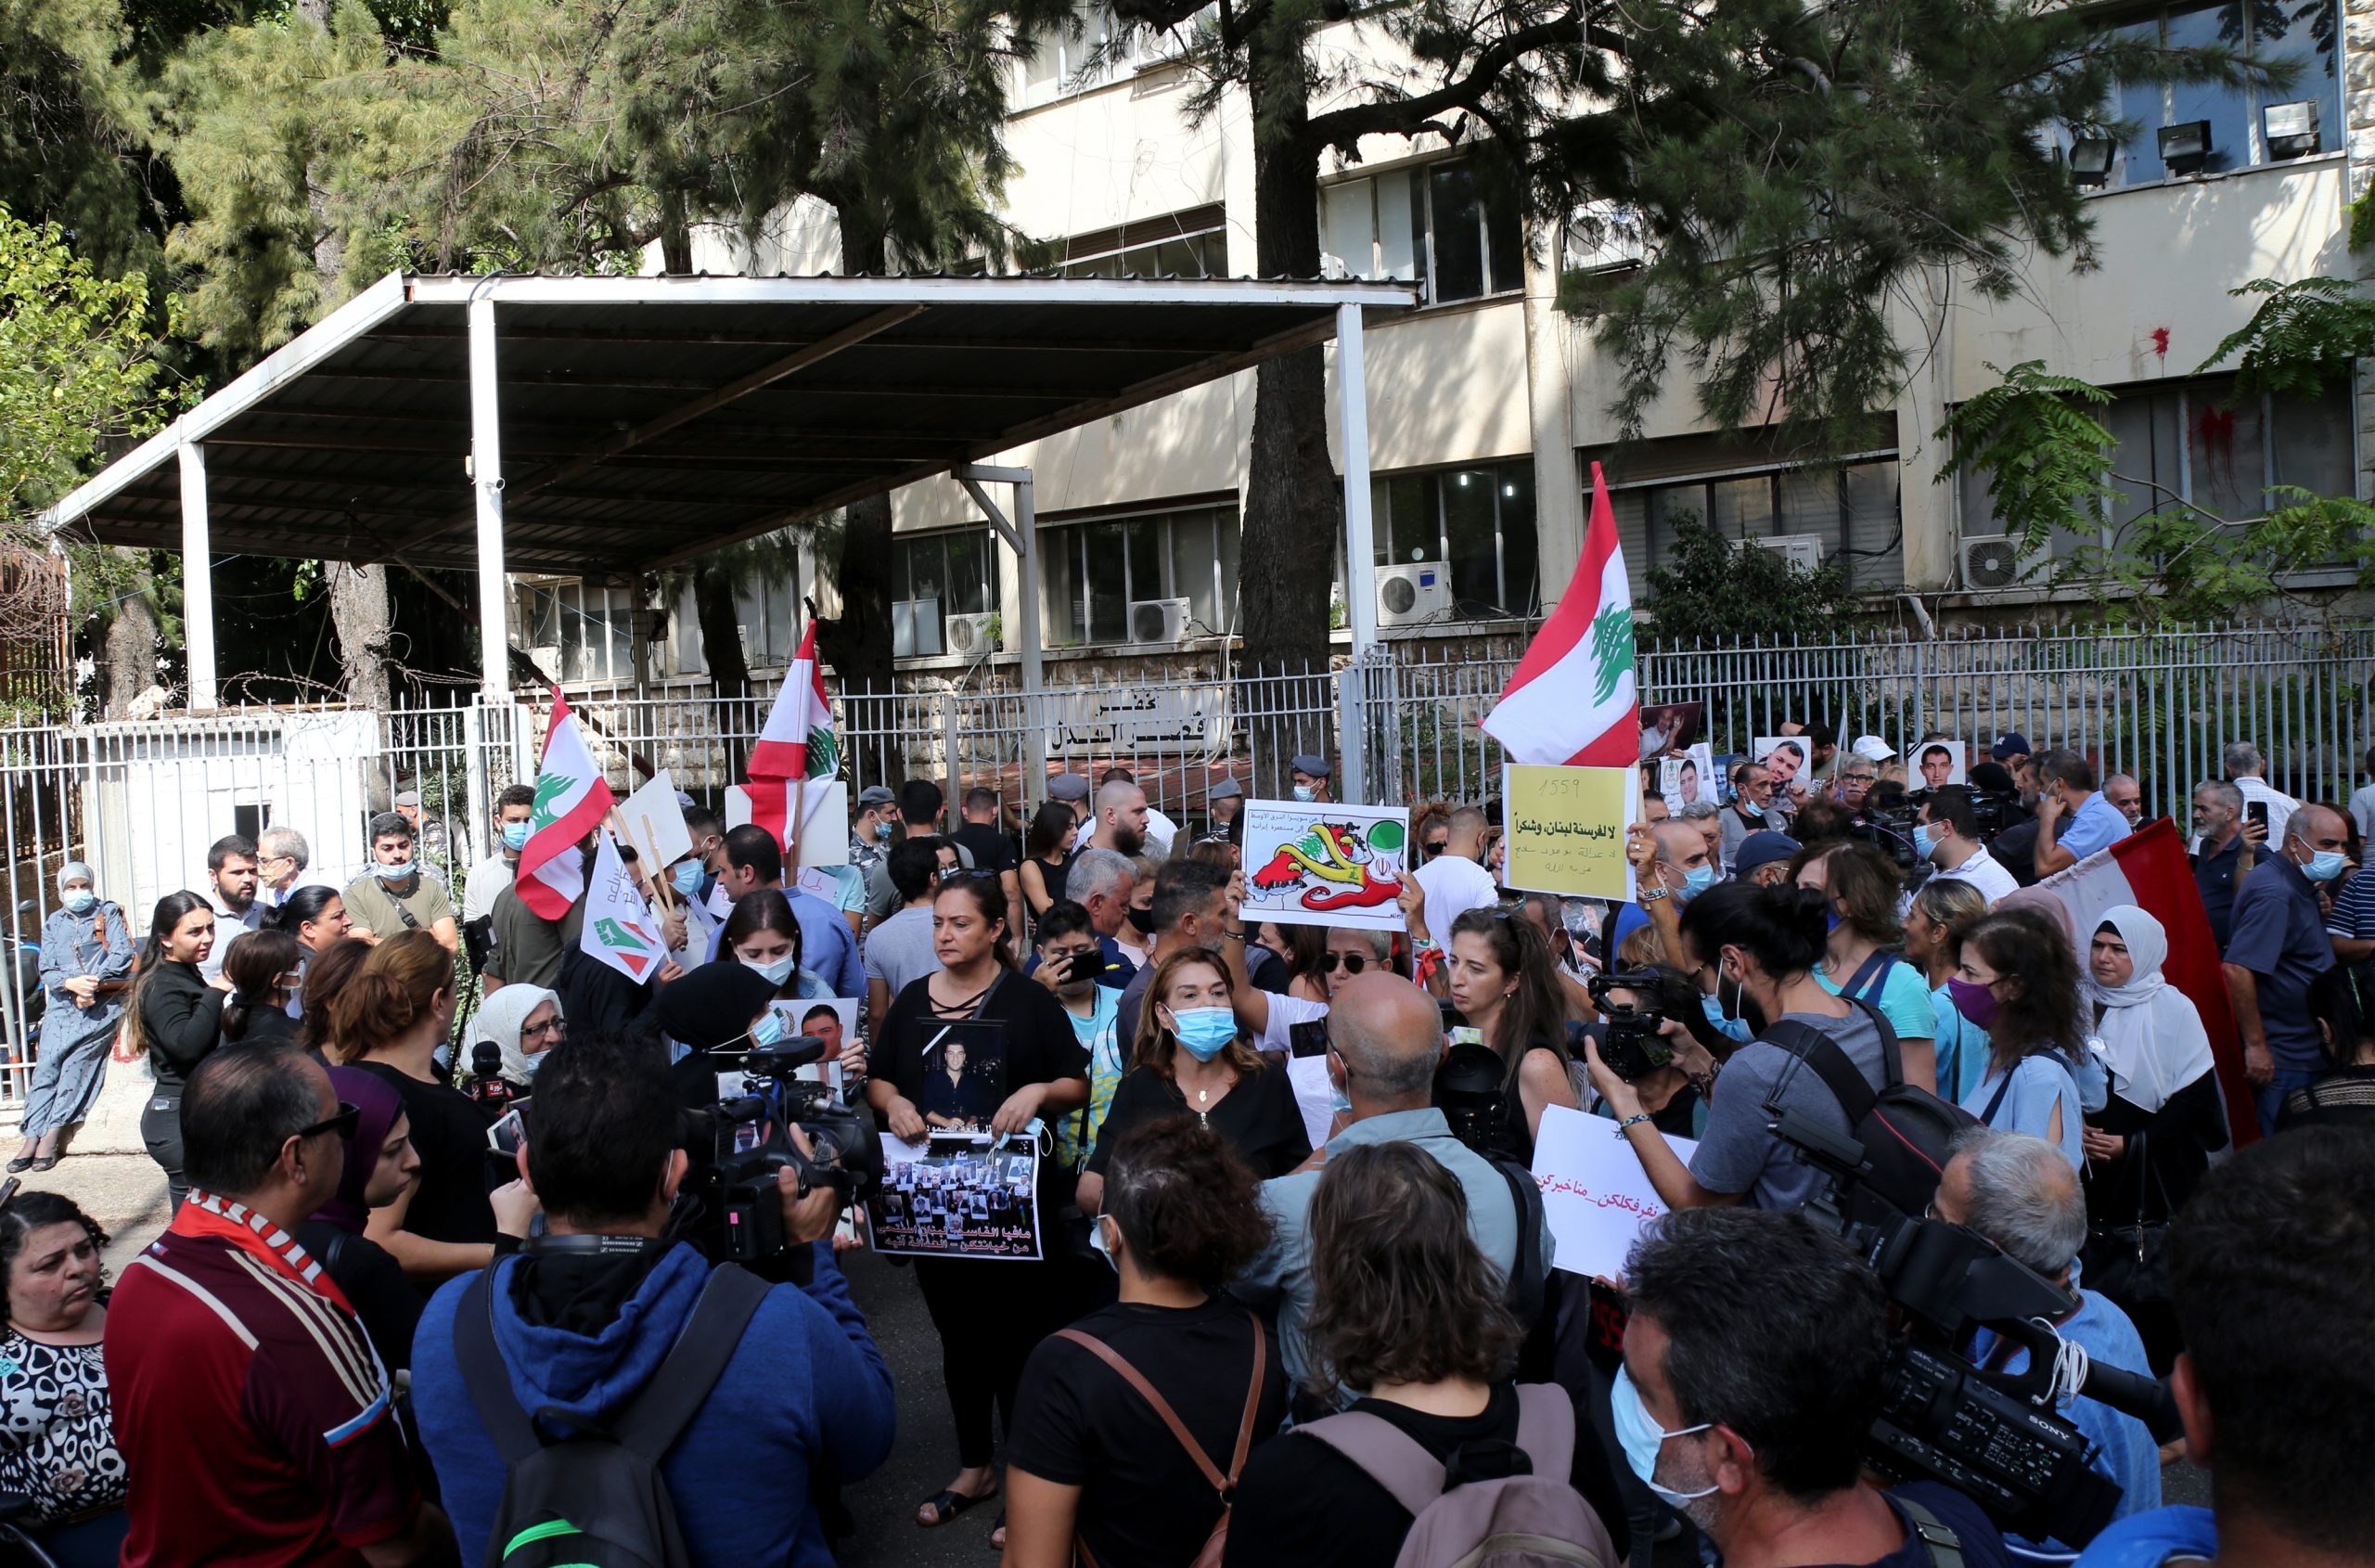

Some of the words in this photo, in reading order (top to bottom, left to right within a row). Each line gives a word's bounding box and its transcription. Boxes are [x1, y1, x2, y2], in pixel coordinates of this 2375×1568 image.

[1537, 778, 1581, 800] 1559
[1573, 822, 1607, 841] لفرسنة
[1608, 825, 1616, 840] لا
[1013, 1242, 1030, 1254] من
[2029, 1415, 2071, 1441] SONY
